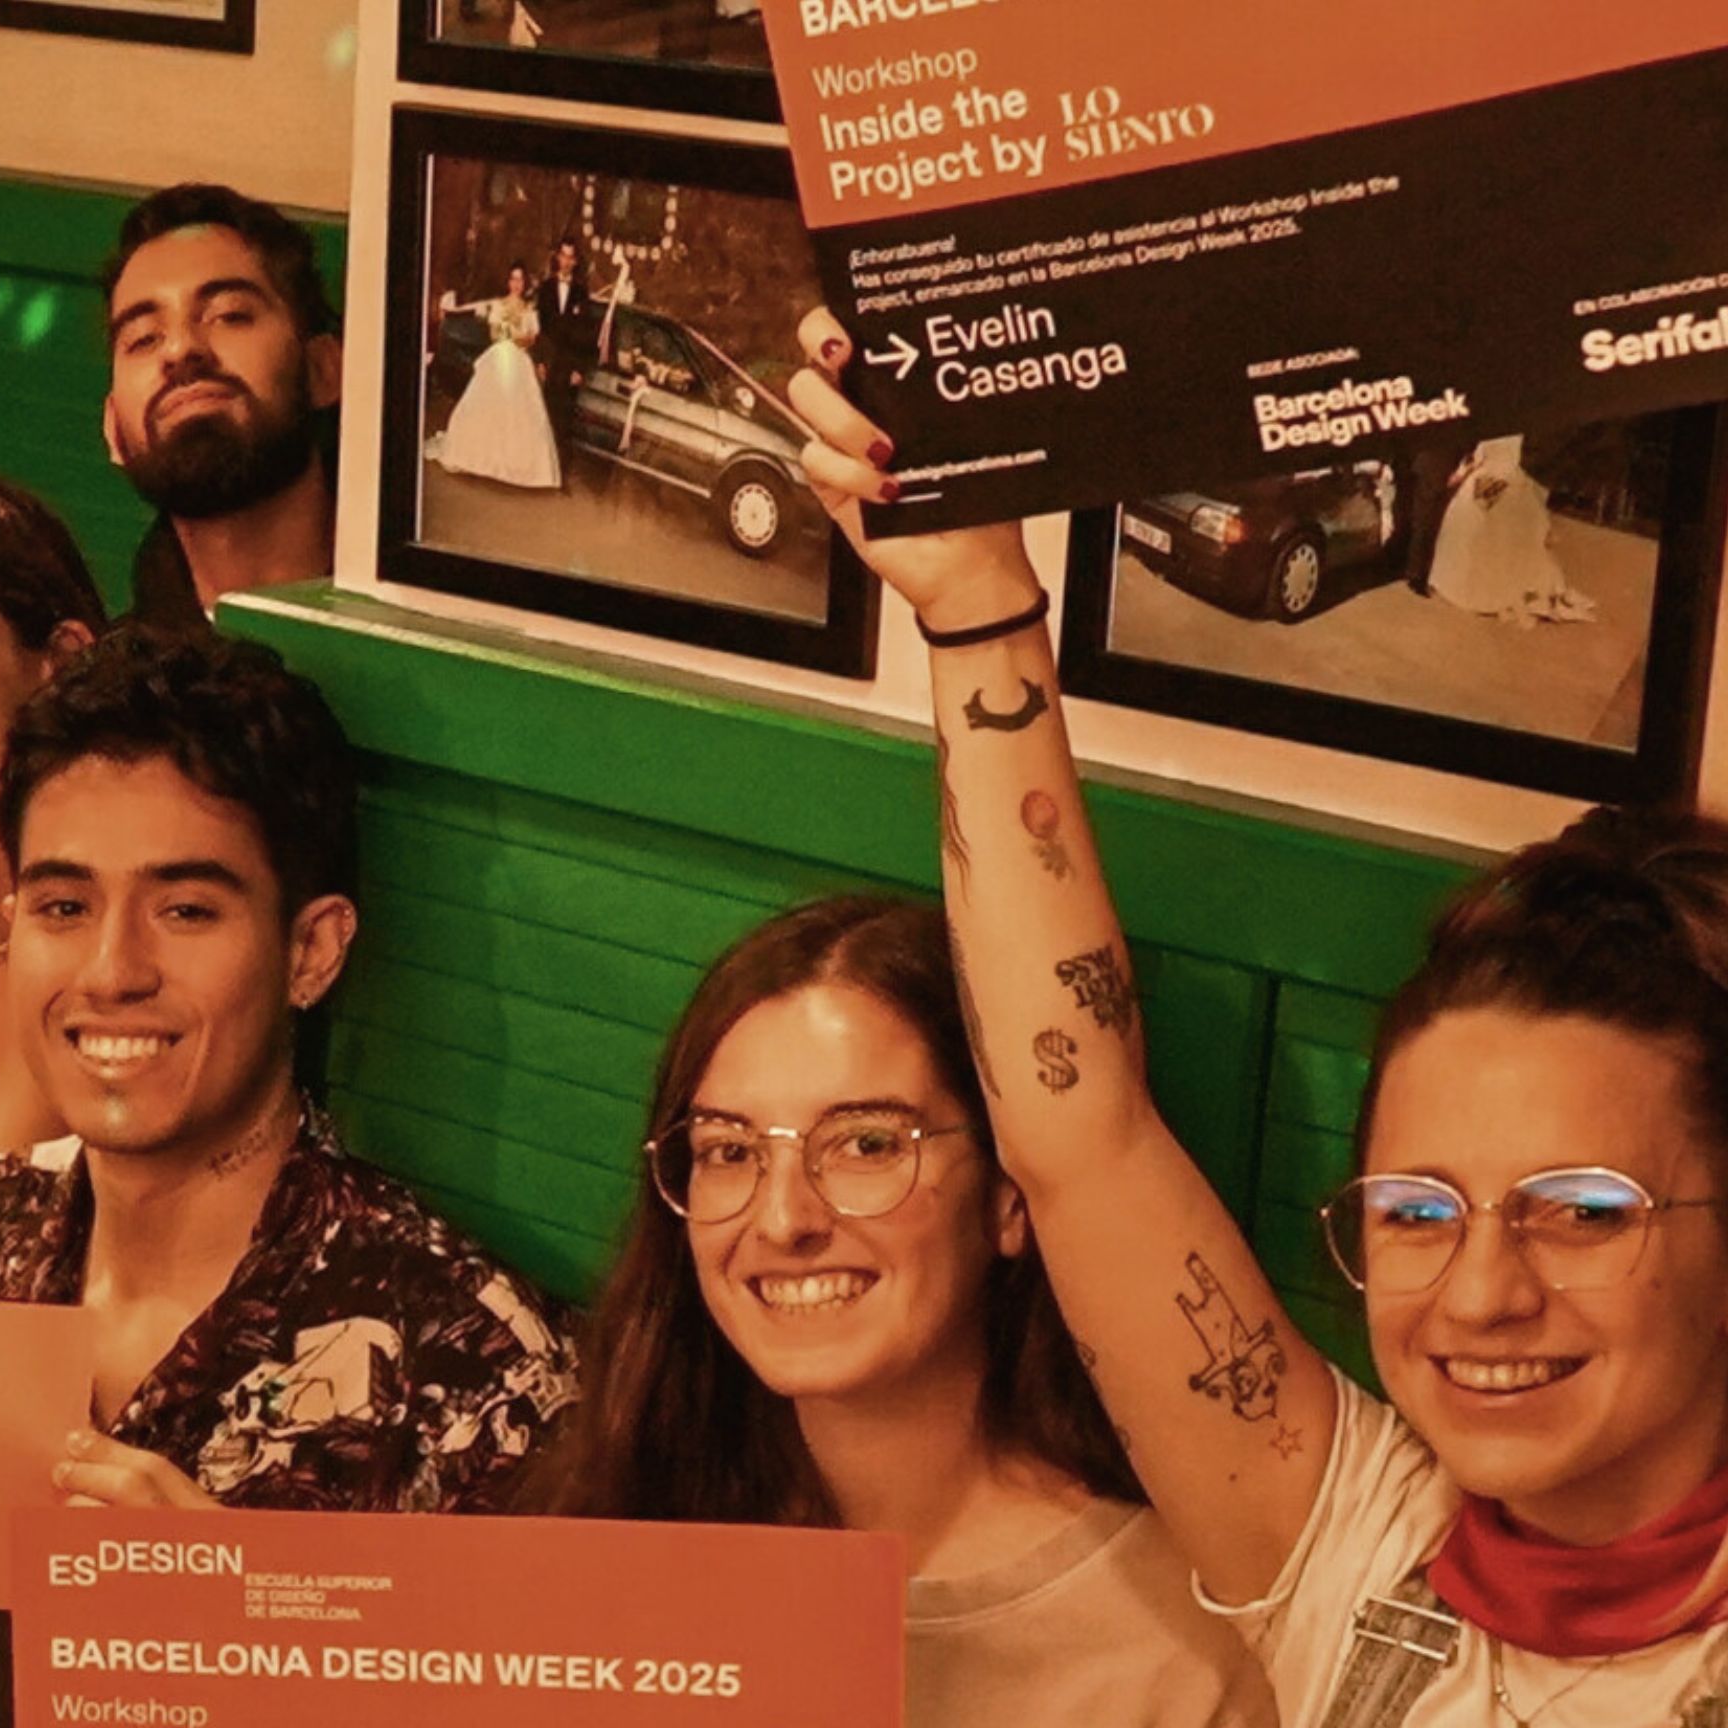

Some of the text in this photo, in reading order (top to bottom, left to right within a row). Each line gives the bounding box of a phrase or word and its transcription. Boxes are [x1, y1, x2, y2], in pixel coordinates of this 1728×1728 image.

[812, 47, 978, 99] Workshop
[819, 86, 1028, 152] Inside the
[1059, 86, 1121, 126] LO
[1064, 104, 1215, 161] SIENTO
[829, 134, 1046, 201] Project by
[925, 304, 1056, 357] Evelin
[935, 343, 1127, 402] Casanga
[1253, 375, 1414, 431] Barcelona
[1258, 388, 1470, 452] Design Week
[48, 1540, 243, 1587] ESDESIGN
[51, 1637, 741, 1697] BARCELONA DESIGN WEEK 2025
